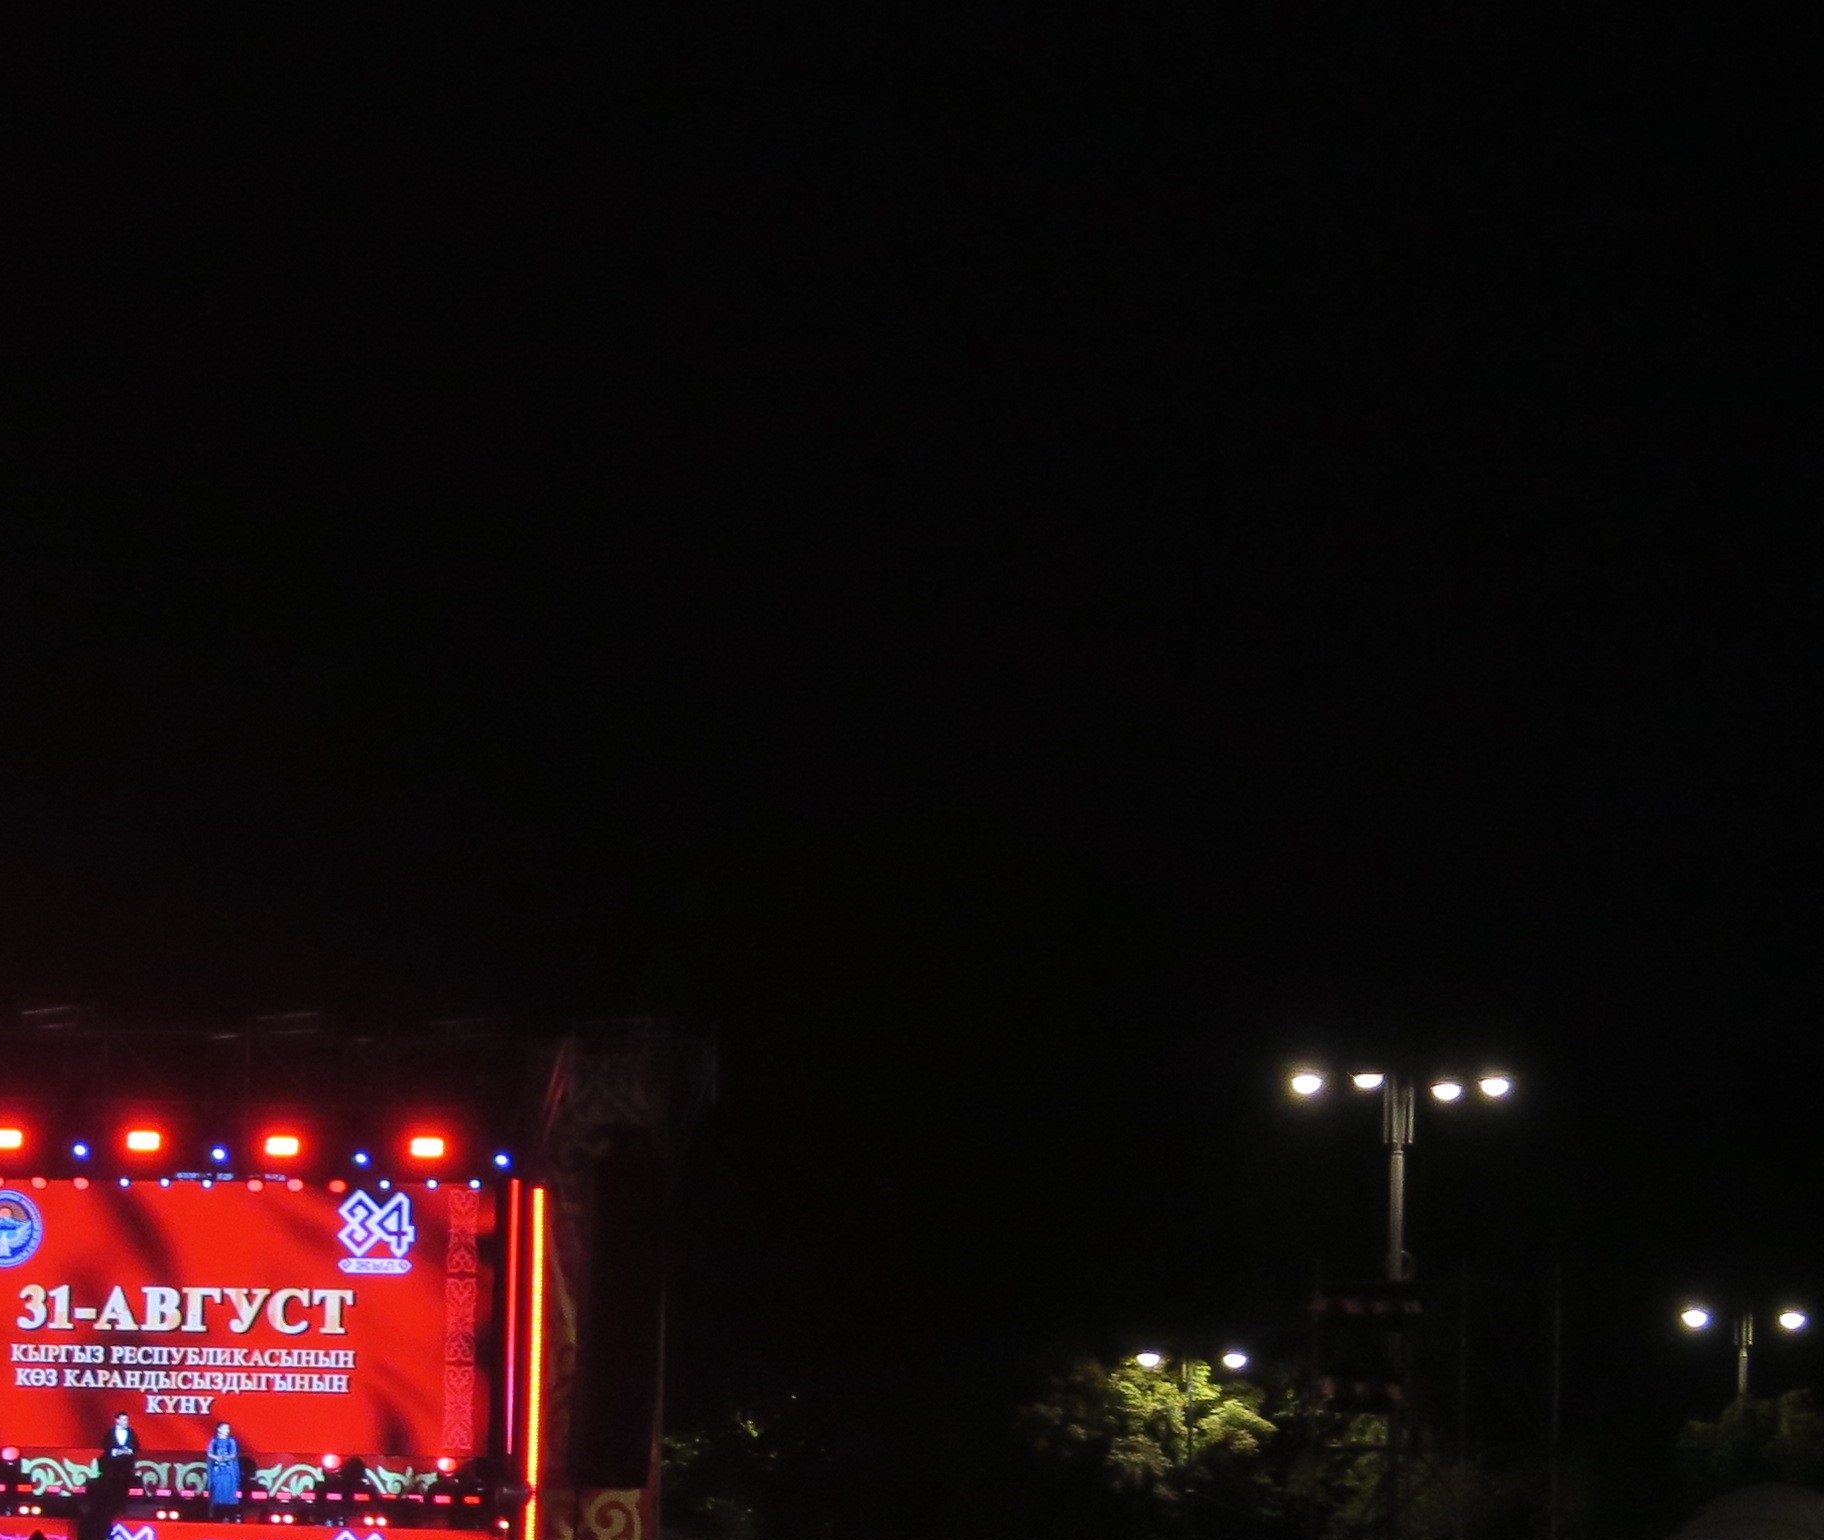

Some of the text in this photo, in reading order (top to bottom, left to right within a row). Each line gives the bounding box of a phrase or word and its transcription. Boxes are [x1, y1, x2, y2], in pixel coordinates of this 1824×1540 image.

[337, 1189, 417, 1258] 34
[16, 1284, 354, 1334] 31-АВГУСТ
[10, 1343, 356, 1369] КЫРГЫЗ РЕСПУБЛИКАСЫНЫН
[14, 1367, 350, 1393] КӨЗ КАРАНДЫСЫЗДЫГЫНЫН
[145, 1394, 215, 1415] КҮНҮ
